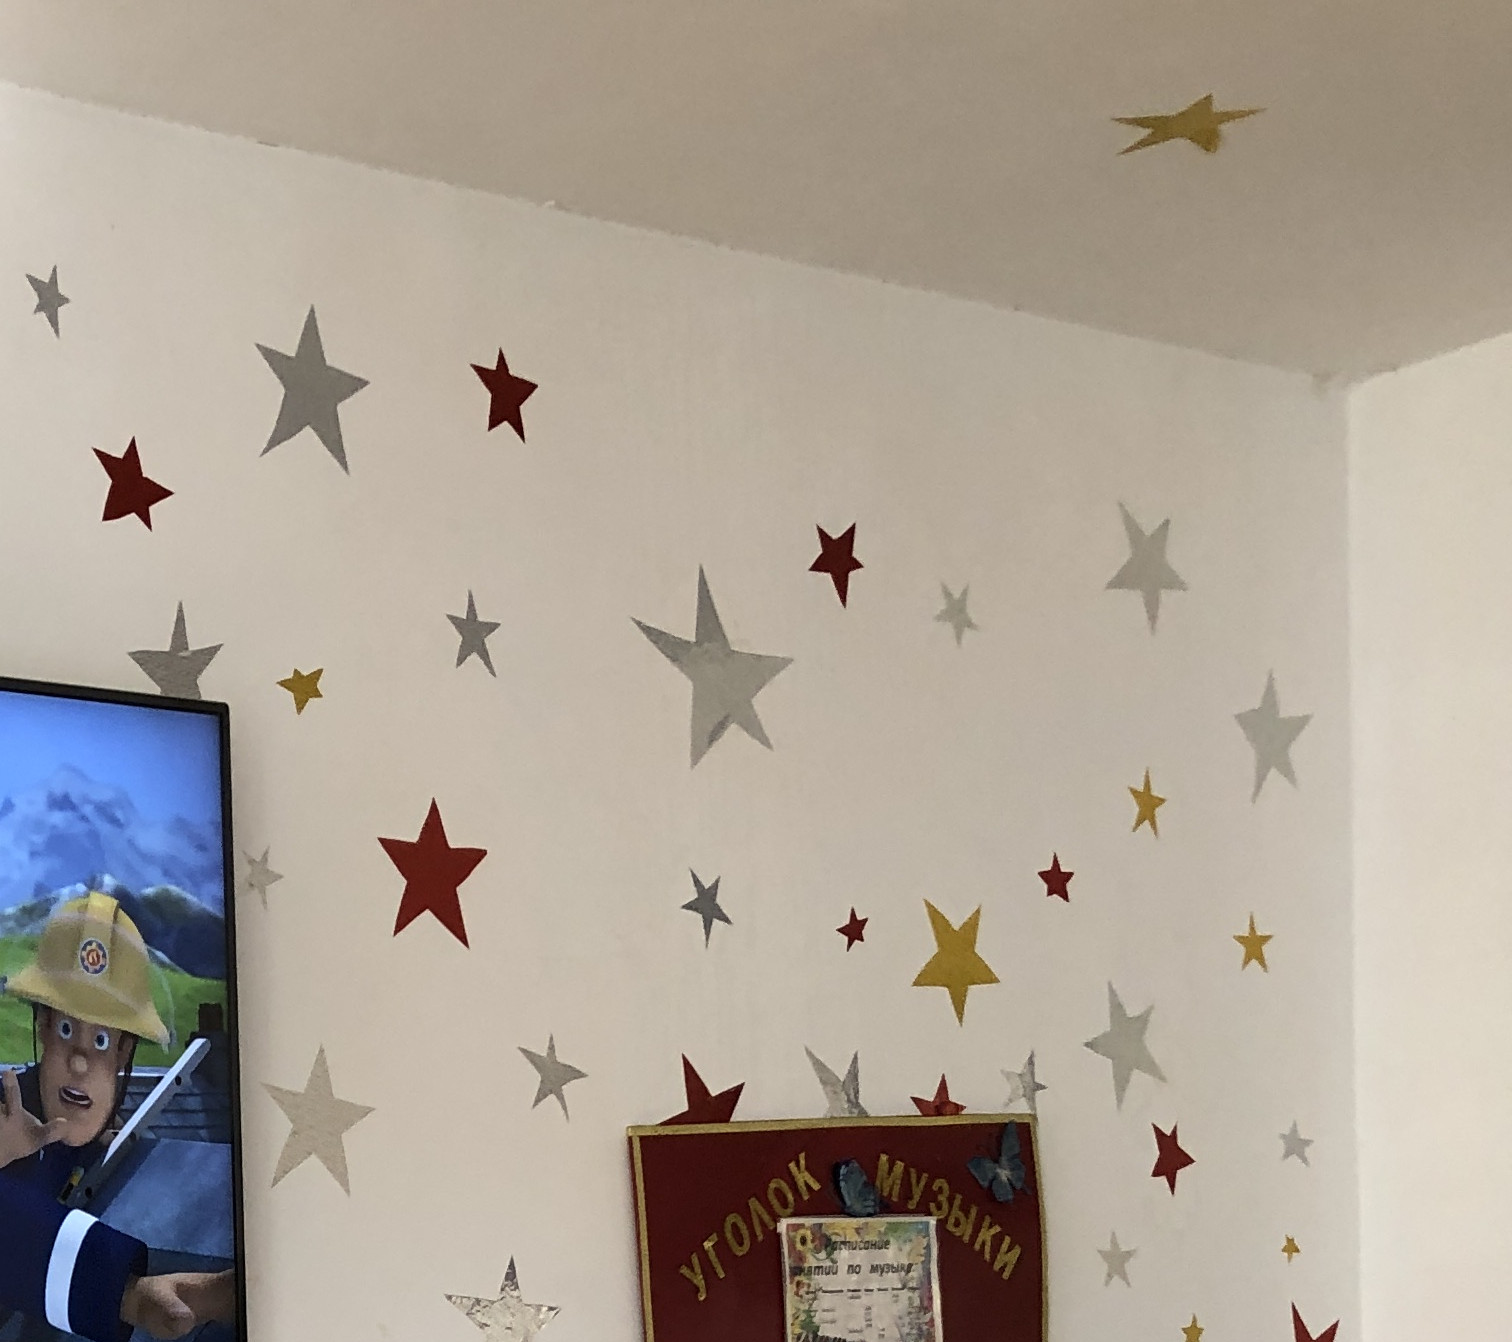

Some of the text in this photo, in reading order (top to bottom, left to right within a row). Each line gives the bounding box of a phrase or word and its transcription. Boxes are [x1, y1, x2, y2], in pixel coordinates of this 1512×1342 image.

[680, 1152, 1022, 1301] УГОЛОК МУЗЫКИ
[847, 1264, 861, 1275] по
